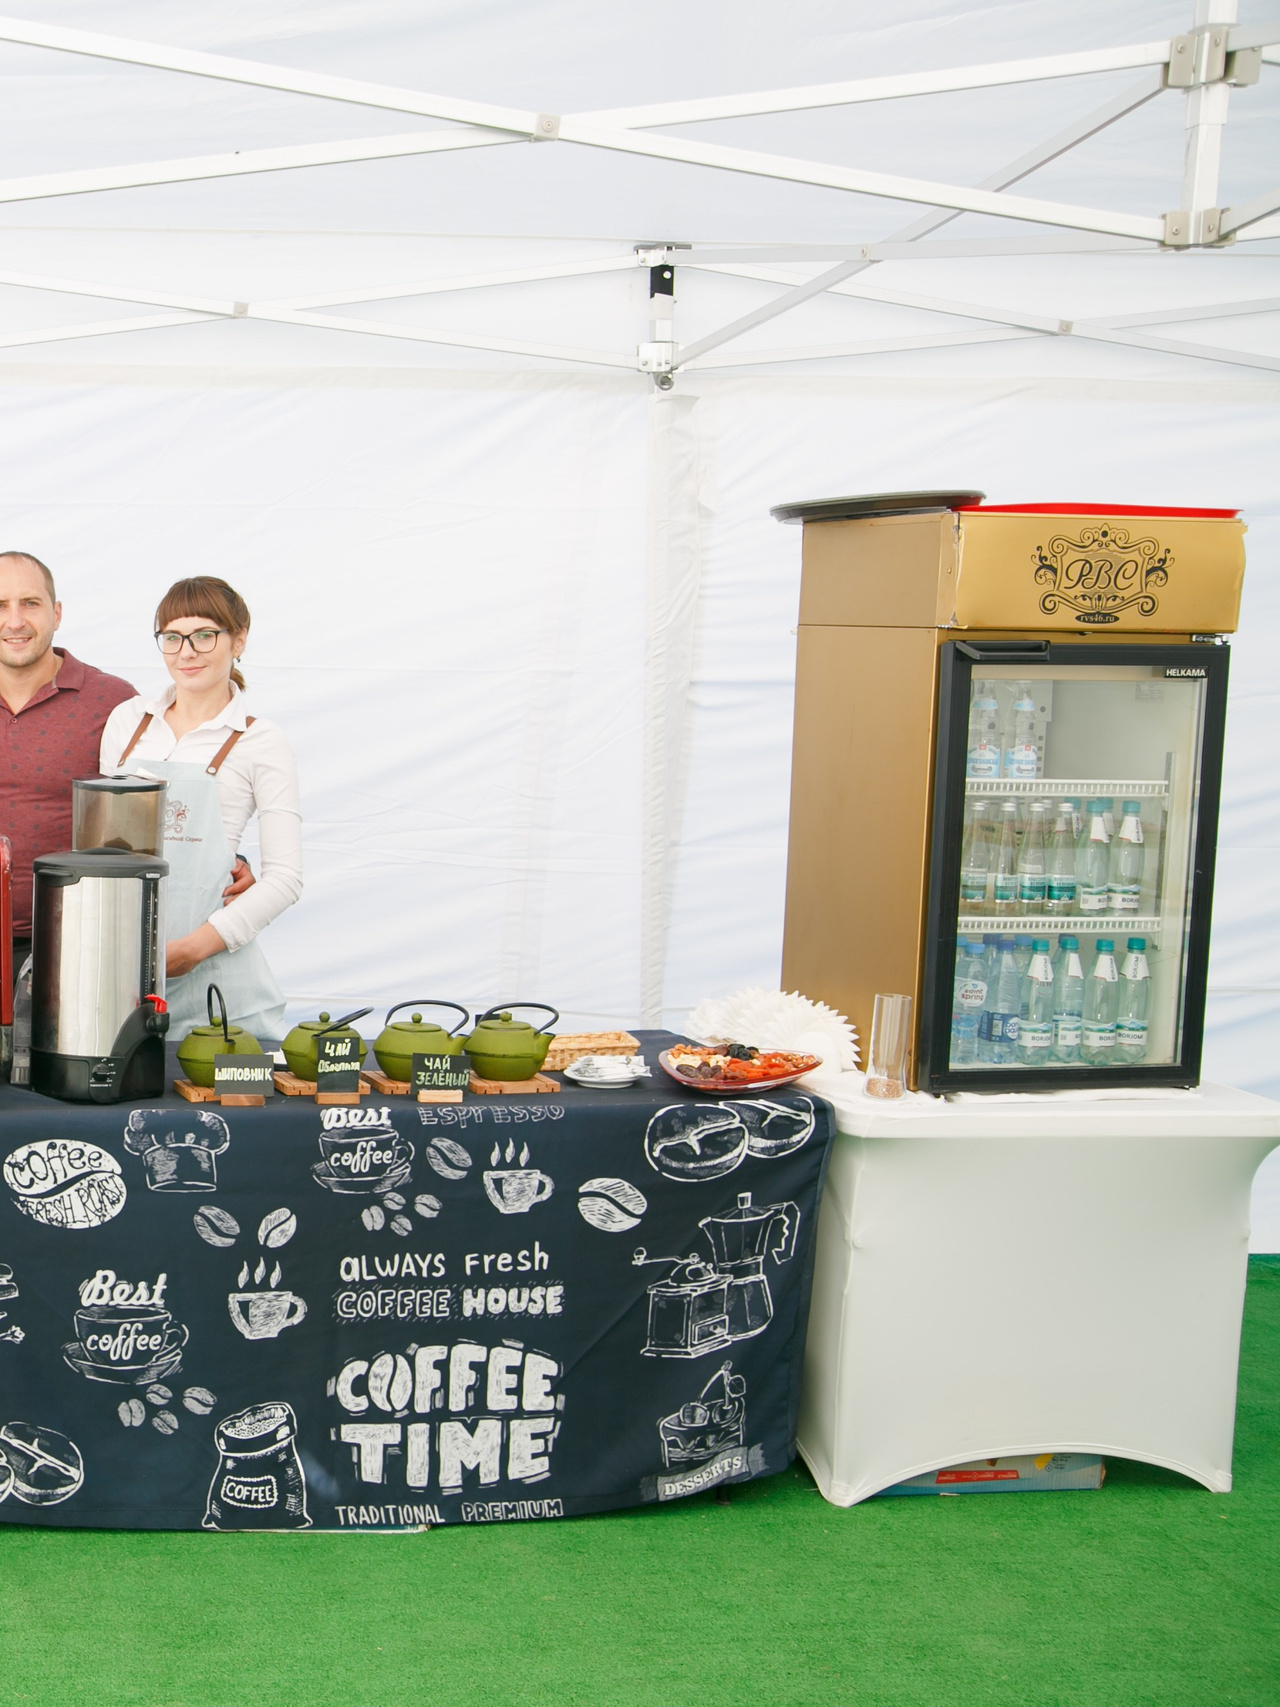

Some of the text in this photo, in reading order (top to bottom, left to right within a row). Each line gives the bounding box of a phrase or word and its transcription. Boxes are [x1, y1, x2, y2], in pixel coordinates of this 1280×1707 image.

[1166, 668, 1206, 677] HELKAMA
[961, 993, 984, 1002] spring
[424, 1054, 451, 1071] ЧАЙ
[322, 1106, 392, 1130] Best
[330, 1141, 393, 1173] coffee
[81, 1269, 167, 1307] Best
[336, 1285, 564, 1319] COFFEE HOUSE
[86, 1322, 162, 1360] coffee
[335, 1343, 559, 1414] COFFEE
[340, 1416, 556, 1488] TIME
[225, 1479, 275, 1503] COFFEE
[664, 1455, 742, 1496] DESSERTS
[334, 1498, 564, 1526] TRADITIONAL PREMIUM
